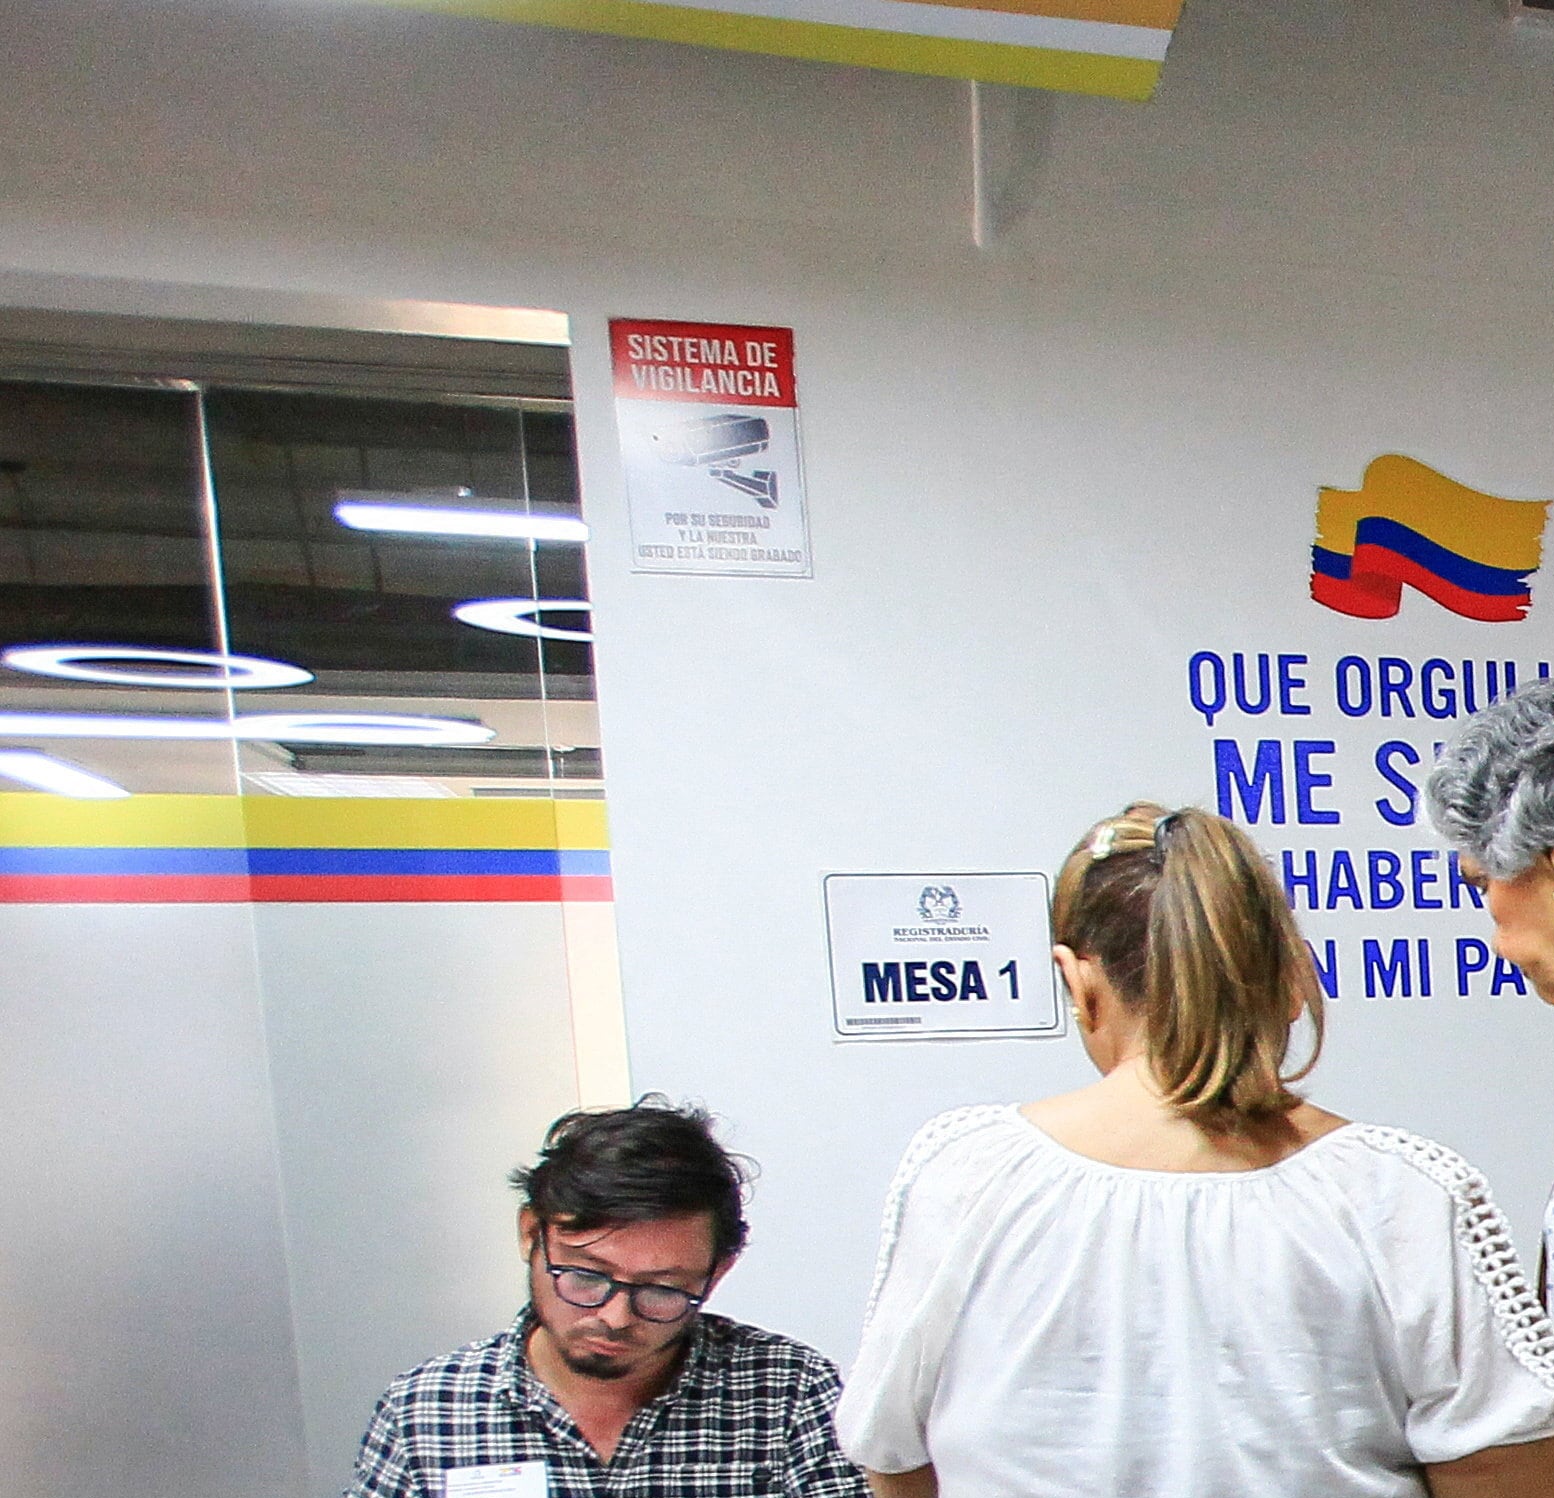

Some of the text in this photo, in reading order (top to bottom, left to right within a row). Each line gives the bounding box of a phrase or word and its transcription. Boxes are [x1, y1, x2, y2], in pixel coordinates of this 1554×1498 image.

[626, 334, 779, 368] SISTEMA DE
[630, 363, 781, 398] VIGILANCIA
[664, 511, 688, 526] POR
[690, 513, 706, 527] SU
[689, 530, 704, 543] LA
[1188, 650, 1312, 727] QUE
[1213, 739, 1341, 825] ME
[893, 924, 990, 937] REGISTRADURÍA
[861, 959, 1020, 1003] MESA 1
[1362, 938, 1432, 998] MI
[1455, 937, 1528, 997] PA
